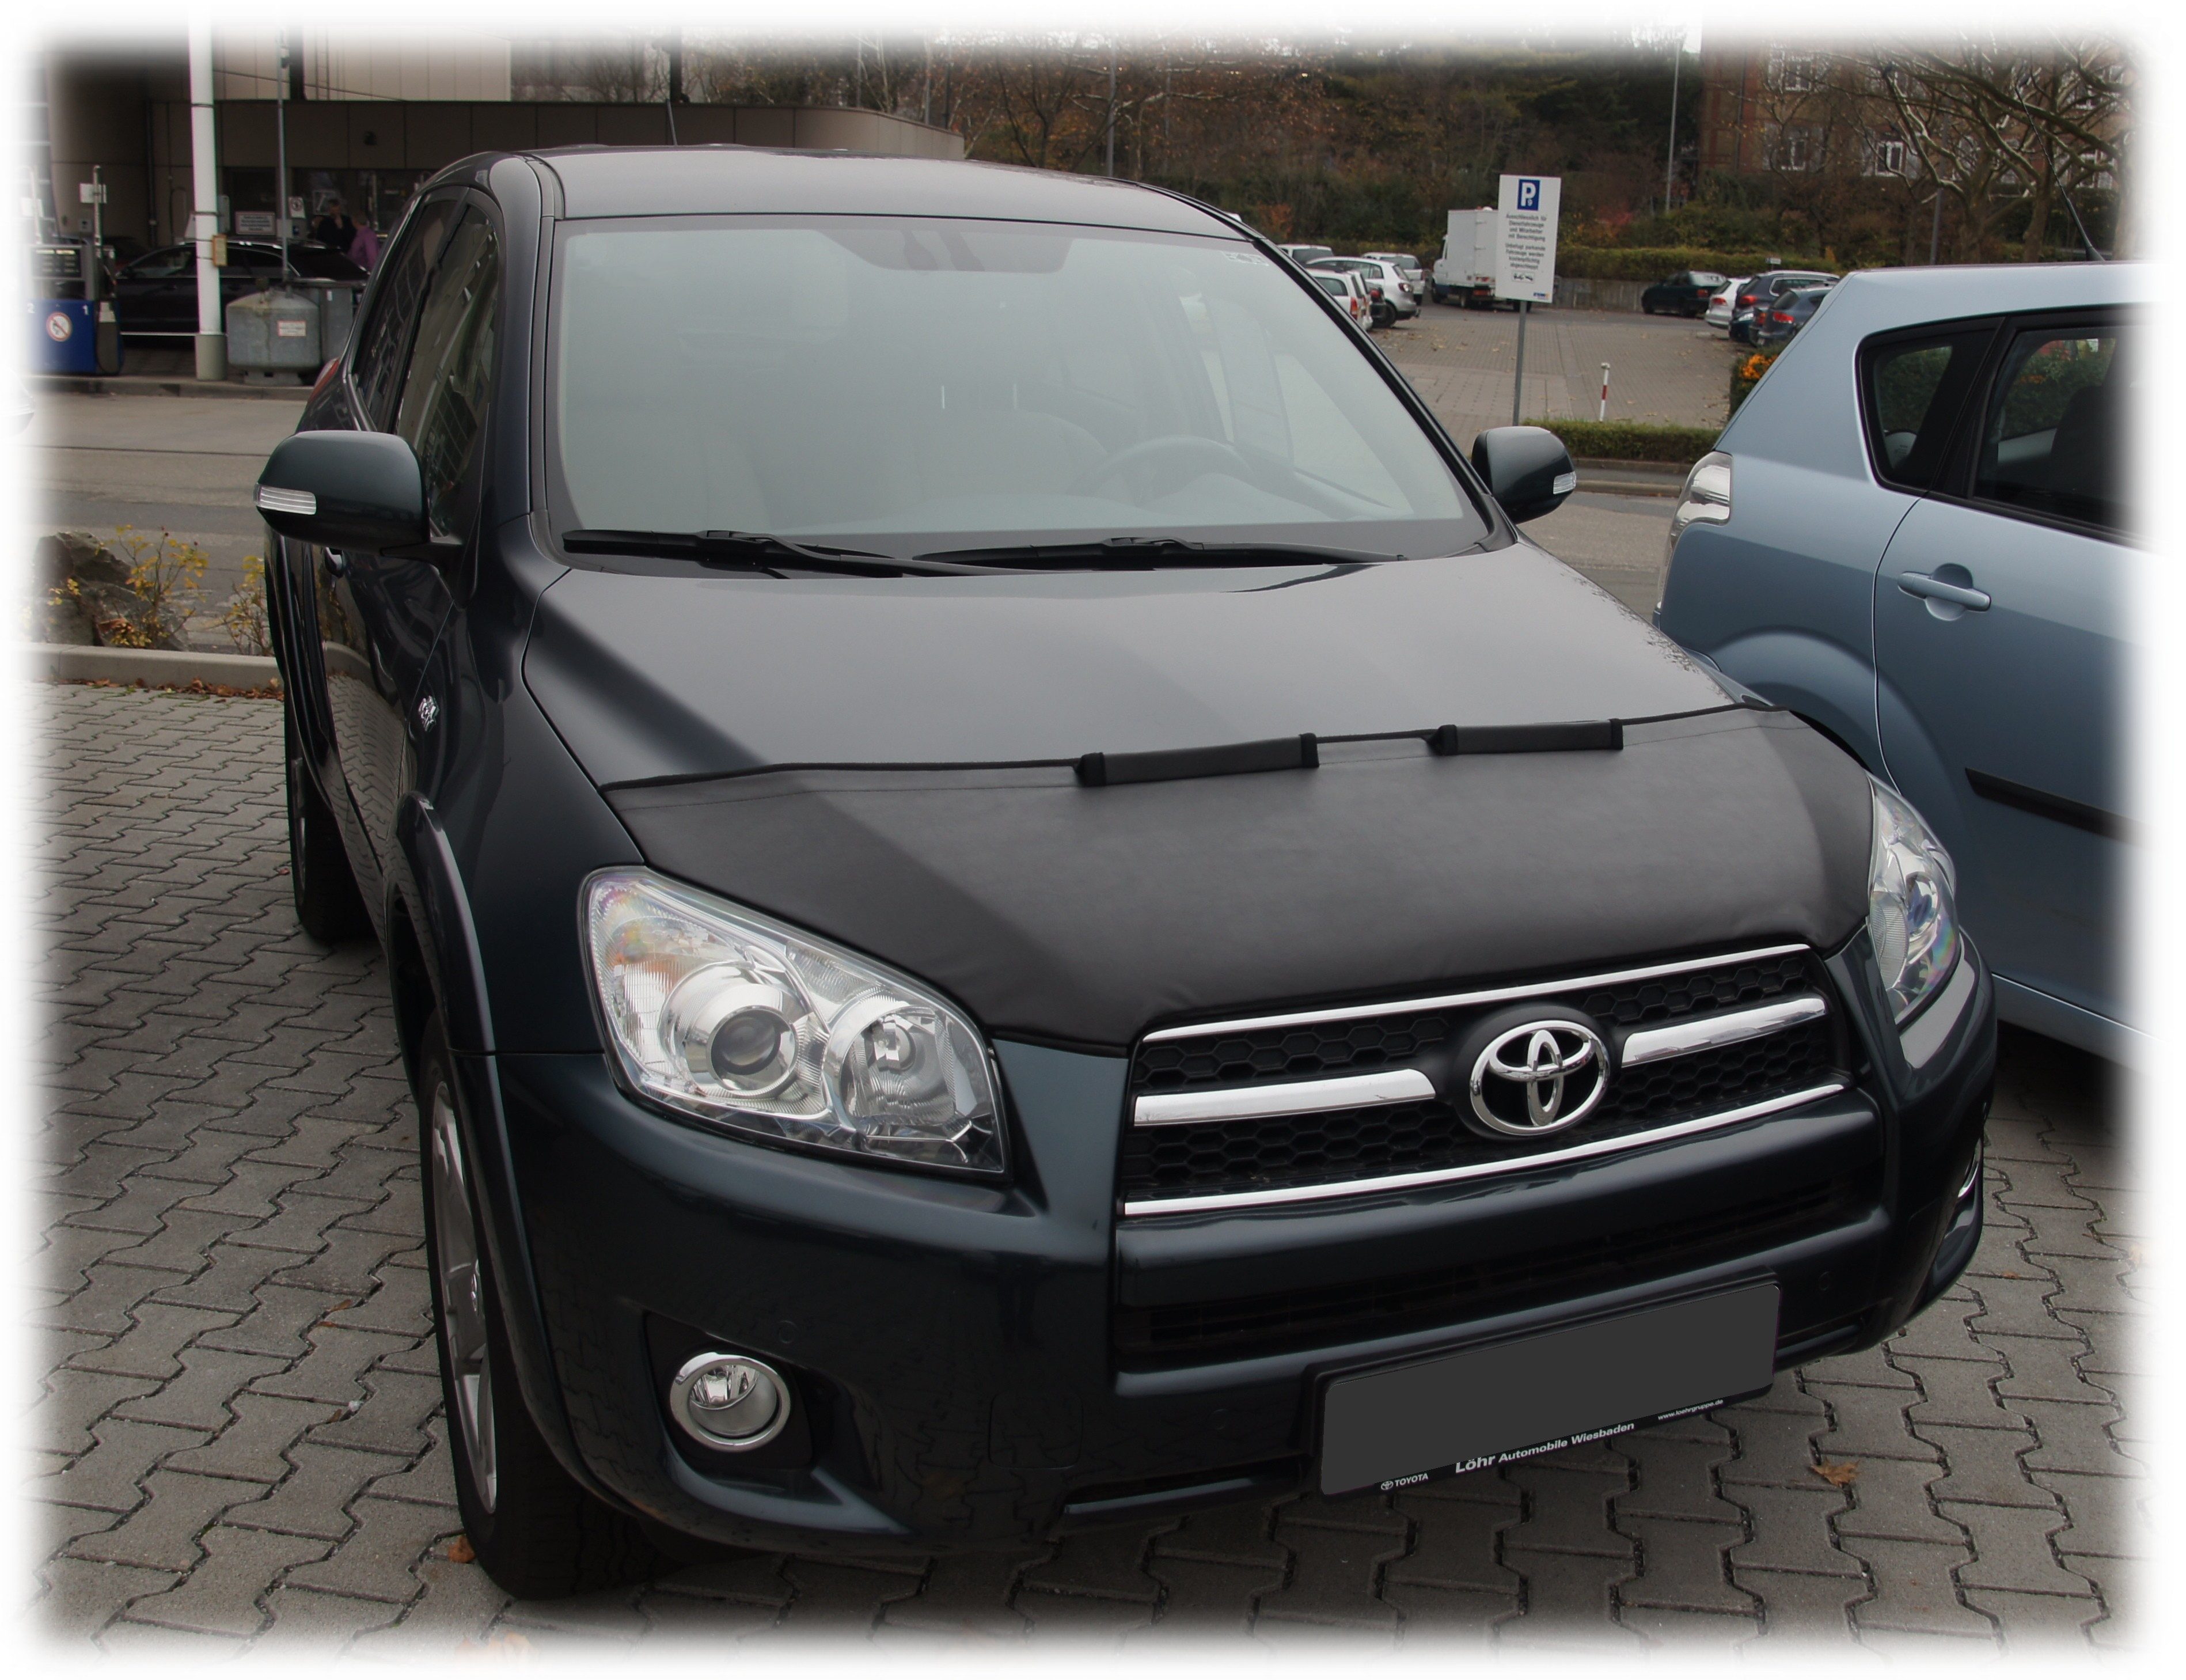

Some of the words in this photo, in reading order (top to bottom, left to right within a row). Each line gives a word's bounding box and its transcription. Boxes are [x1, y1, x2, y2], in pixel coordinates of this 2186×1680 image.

[1521, 182, 1536, 206] P
[1505, 248, 1527, 256] Fahrzeuge
[82, 305, 89, 316] 1
[1658, 1399, 1724, 1420] www.loehrgruppe.de
[1455, 1454, 1496, 1473] Löhr
[1498, 1440, 1568, 1463] Automobile
[1571, 1422, 1635, 1444] Wiesbaden
[1395, 1473, 1429, 1487] TOYOTA
